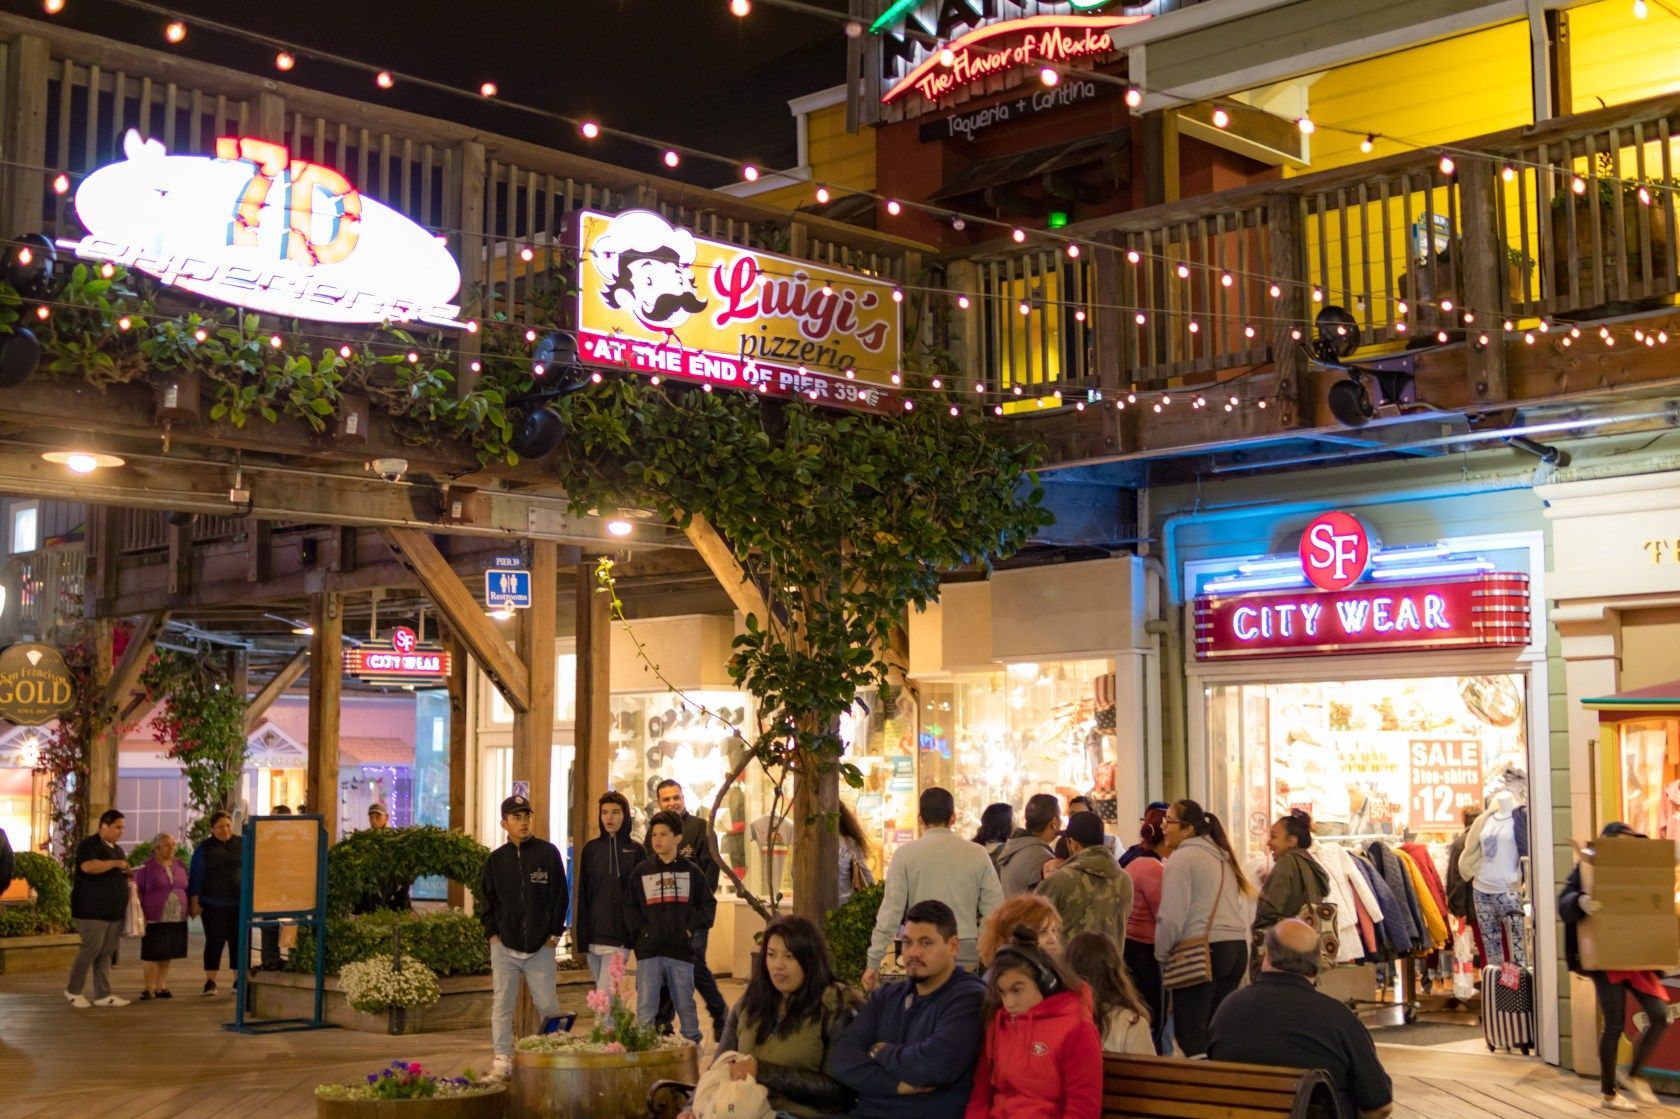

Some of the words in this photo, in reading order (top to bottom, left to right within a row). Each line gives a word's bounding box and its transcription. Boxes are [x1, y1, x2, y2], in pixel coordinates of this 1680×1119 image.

[915, 74, 951, 101] The
[952, 47, 1012, 82] Flavor
[1013, 35, 1036, 62] of
[1039, 26, 1111, 60] Mexico
[947, 102, 1009, 141] Taqueria
[1032, 80, 1095, 112] Cantina
[216, 136, 362, 265] 7D
[712, 256, 889, 351] Luigi's
[593, 338, 626, 361] AT
[632, 345, 682, 372] THE
[689, 354, 737, 381] END
[742, 364, 772, 384] OF
[780, 372, 828, 398] PIER
[834, 383, 858, 402] 39
[739, 325, 856, 371] pizzeria
[496, 557, 512, 566] PIER
[512, 558, 520, 566] 39
[1309, 522, 1359, 580] SF
[490, 591, 528, 601] Restrooms
[1232, 602, 1321, 640] CITY
[1337, 594, 1450, 633] WEAR
[396, 630, 414, 651] SF
[402, 656, 440, 671] WEAR
[1411, 742, 1478, 767] SALE
